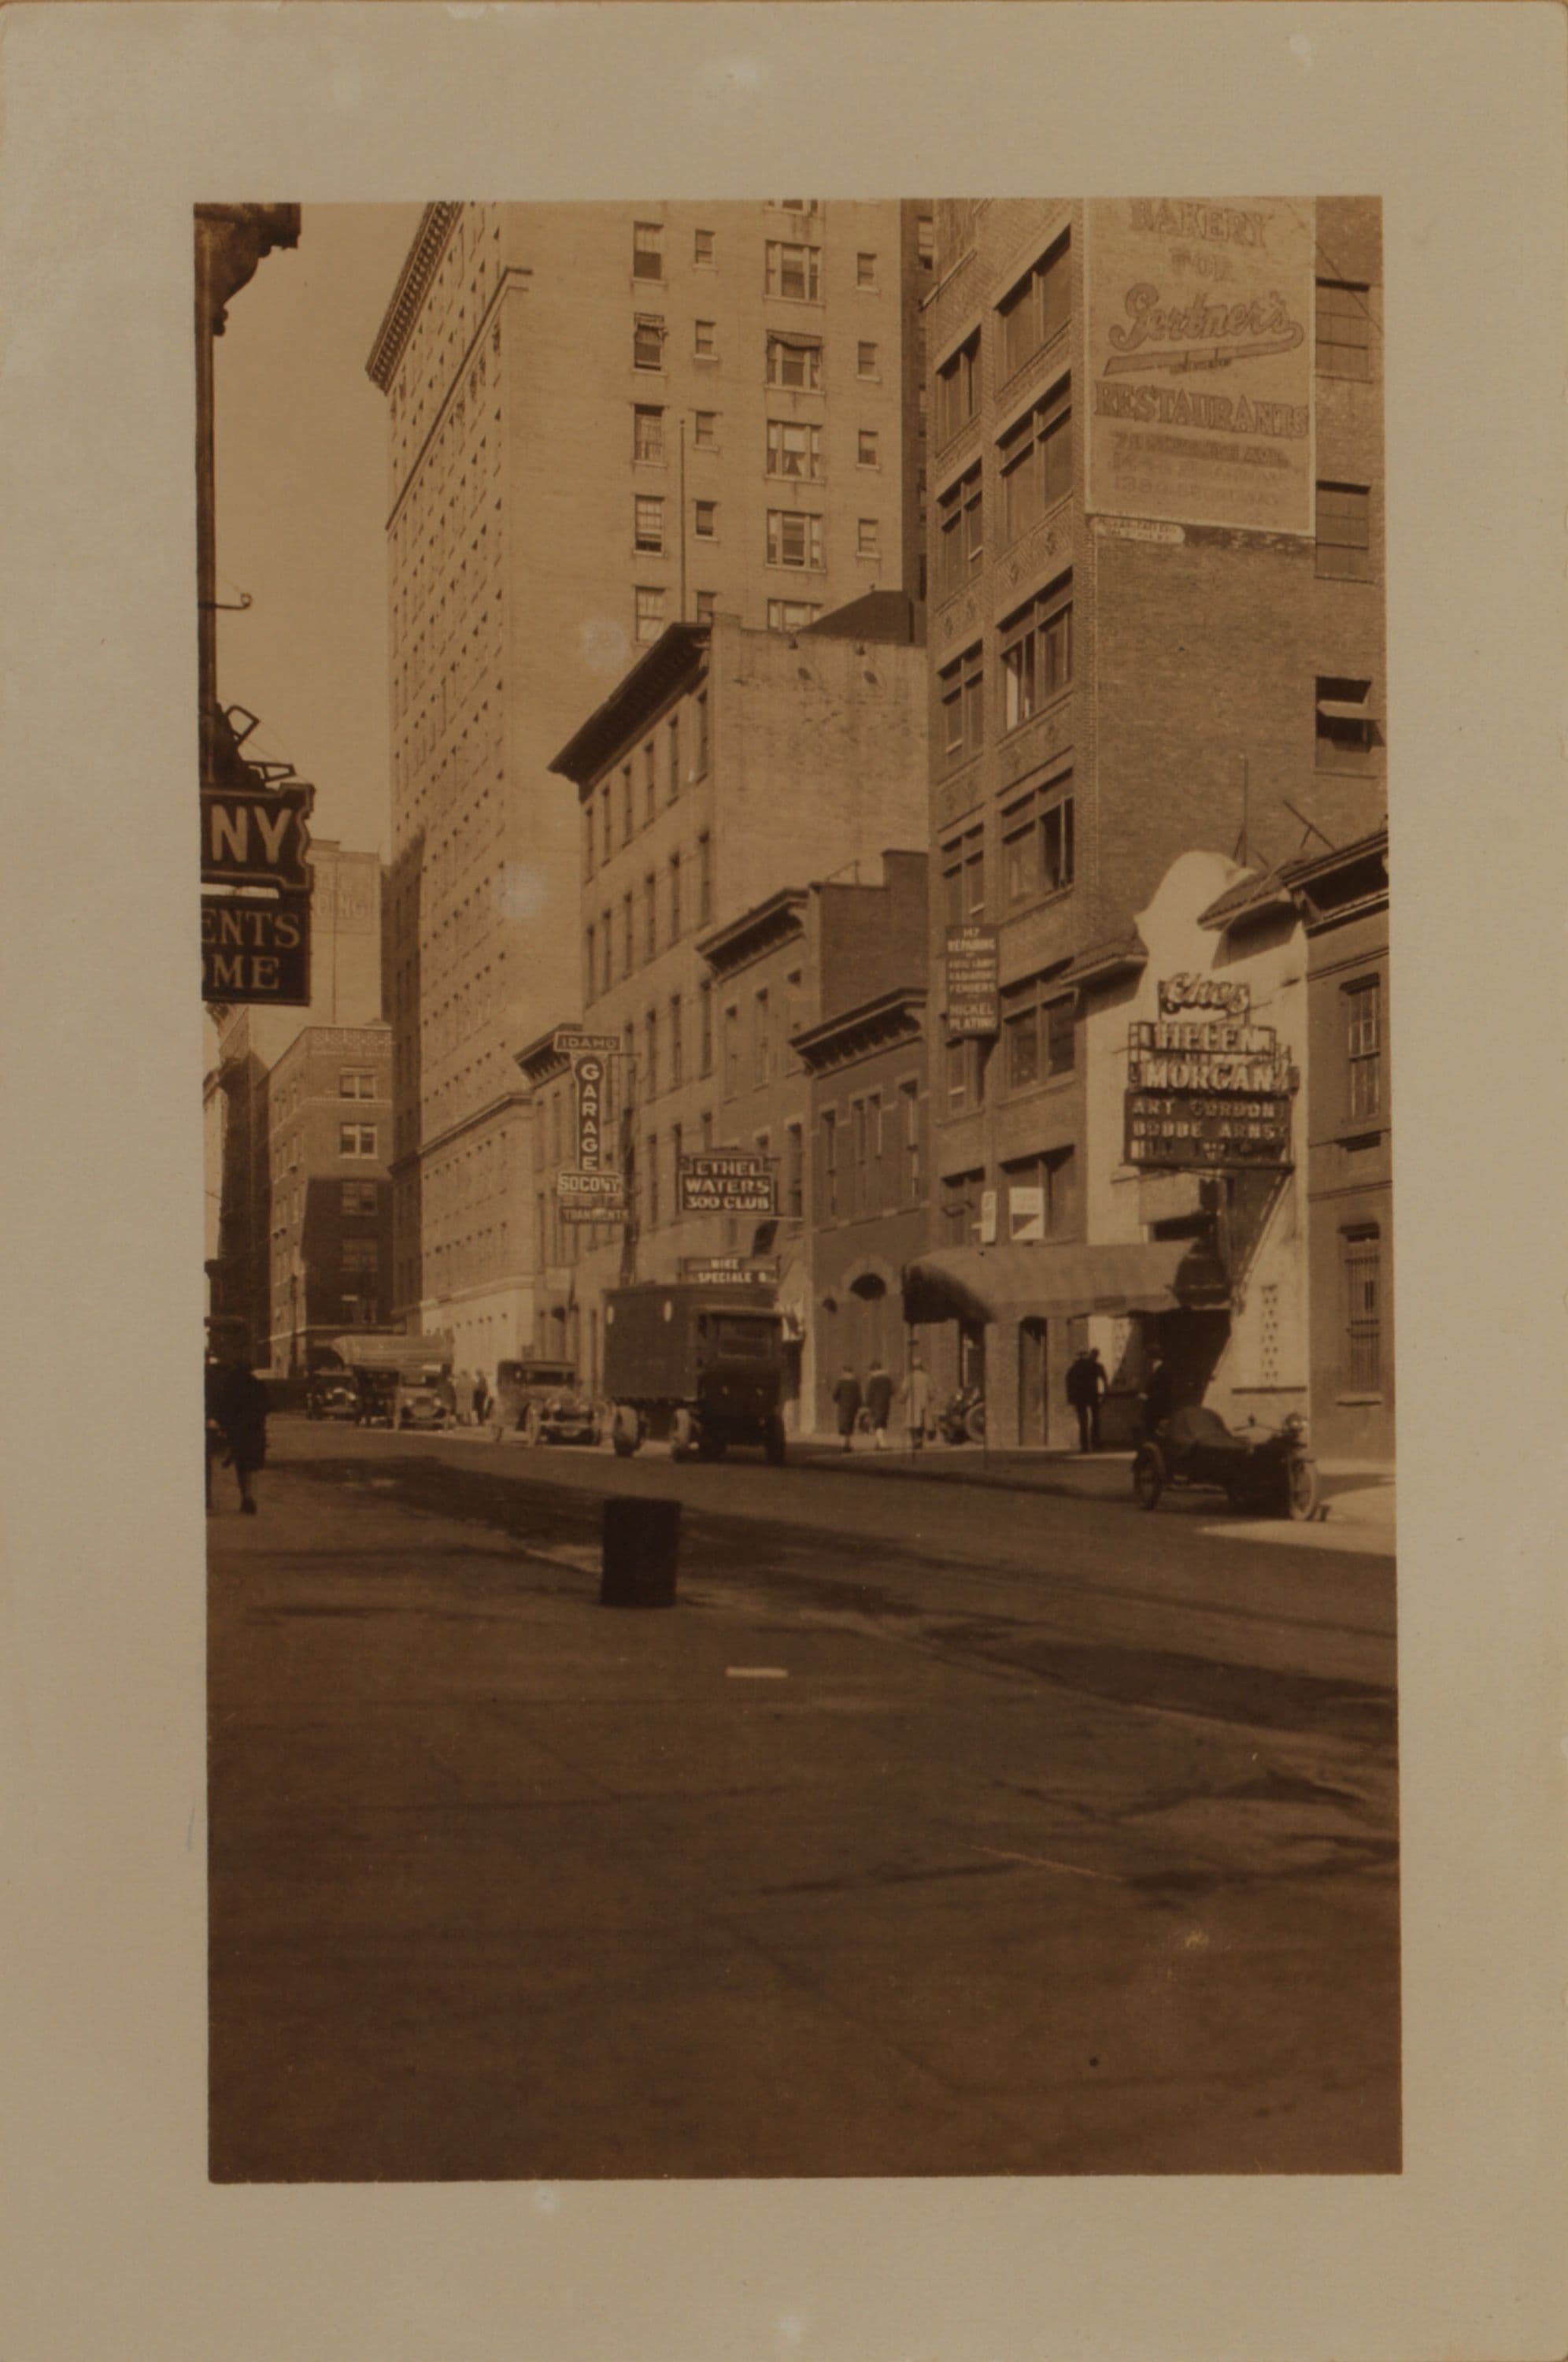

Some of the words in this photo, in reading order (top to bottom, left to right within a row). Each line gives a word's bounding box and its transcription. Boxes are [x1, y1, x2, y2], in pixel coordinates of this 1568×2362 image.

[1094, 379, 1309, 439] RESTAURANTS
[211, 804, 292, 863] NY
[201, 954, 279, 990] ME
[1154, 1023, 1272, 1052] HELEN
[1141, 1059, 1277, 1091] MORGAN
[580, 1063, 601, 1171] GARAGE
[696, 1161, 756, 1176] ETHEL
[685, 1178, 771, 1194] WATERS
[723, 1195, 770, 1209] CLUB
